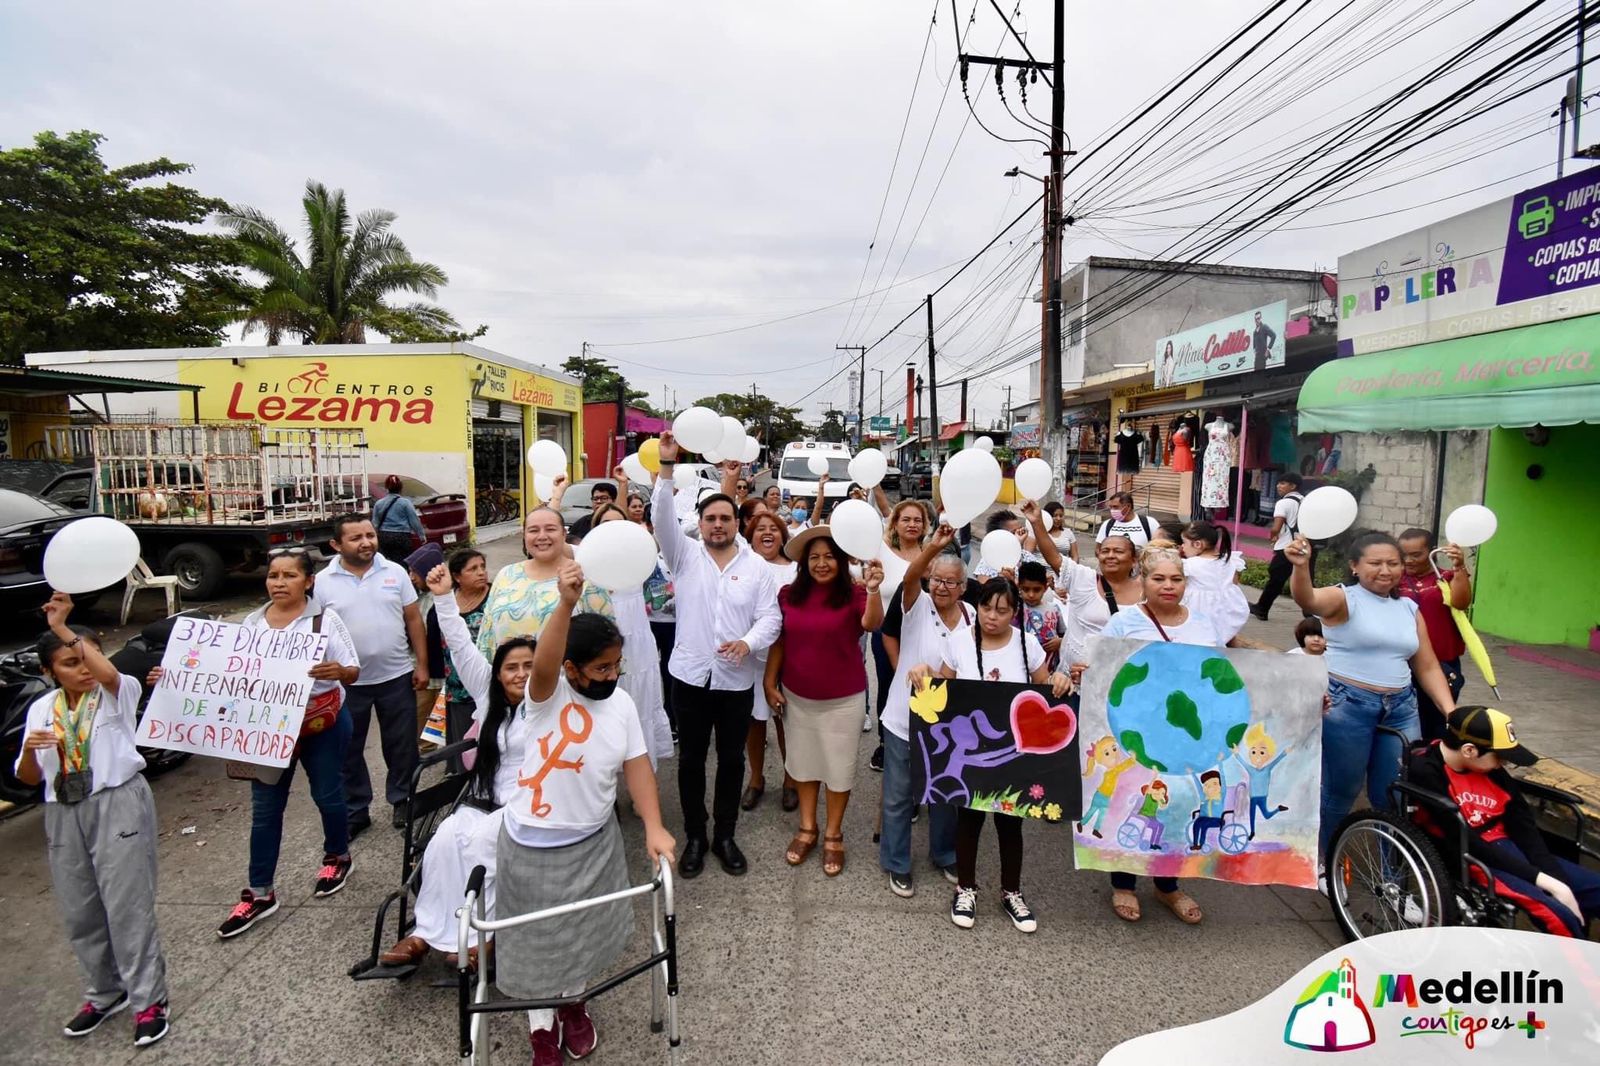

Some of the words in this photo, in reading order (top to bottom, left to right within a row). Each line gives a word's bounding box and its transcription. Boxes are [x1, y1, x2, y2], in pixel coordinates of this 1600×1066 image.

[1534, 236, 1587, 267] COPIAS
[1555, 257, 1600, 286] COPIA
[1342, 256, 1494, 320] PAPELERIA
[1447, 309, 1514, 336] COPIAS
[226, 381, 434, 425] Lezama
[512, 380, 553, 407] Lezama
[176, 620, 196, 642] 3
[197, 621, 228, 648] DE
[233, 626, 329, 662] DICIEMBRE
[224, 655, 262, 677] DIA
[160, 668, 305, 708] INTERNACIONAL
[182, 698, 209, 717] DE
[247, 705, 272, 725] LA
[148, 719, 296, 760] DISCAPACIDAD
